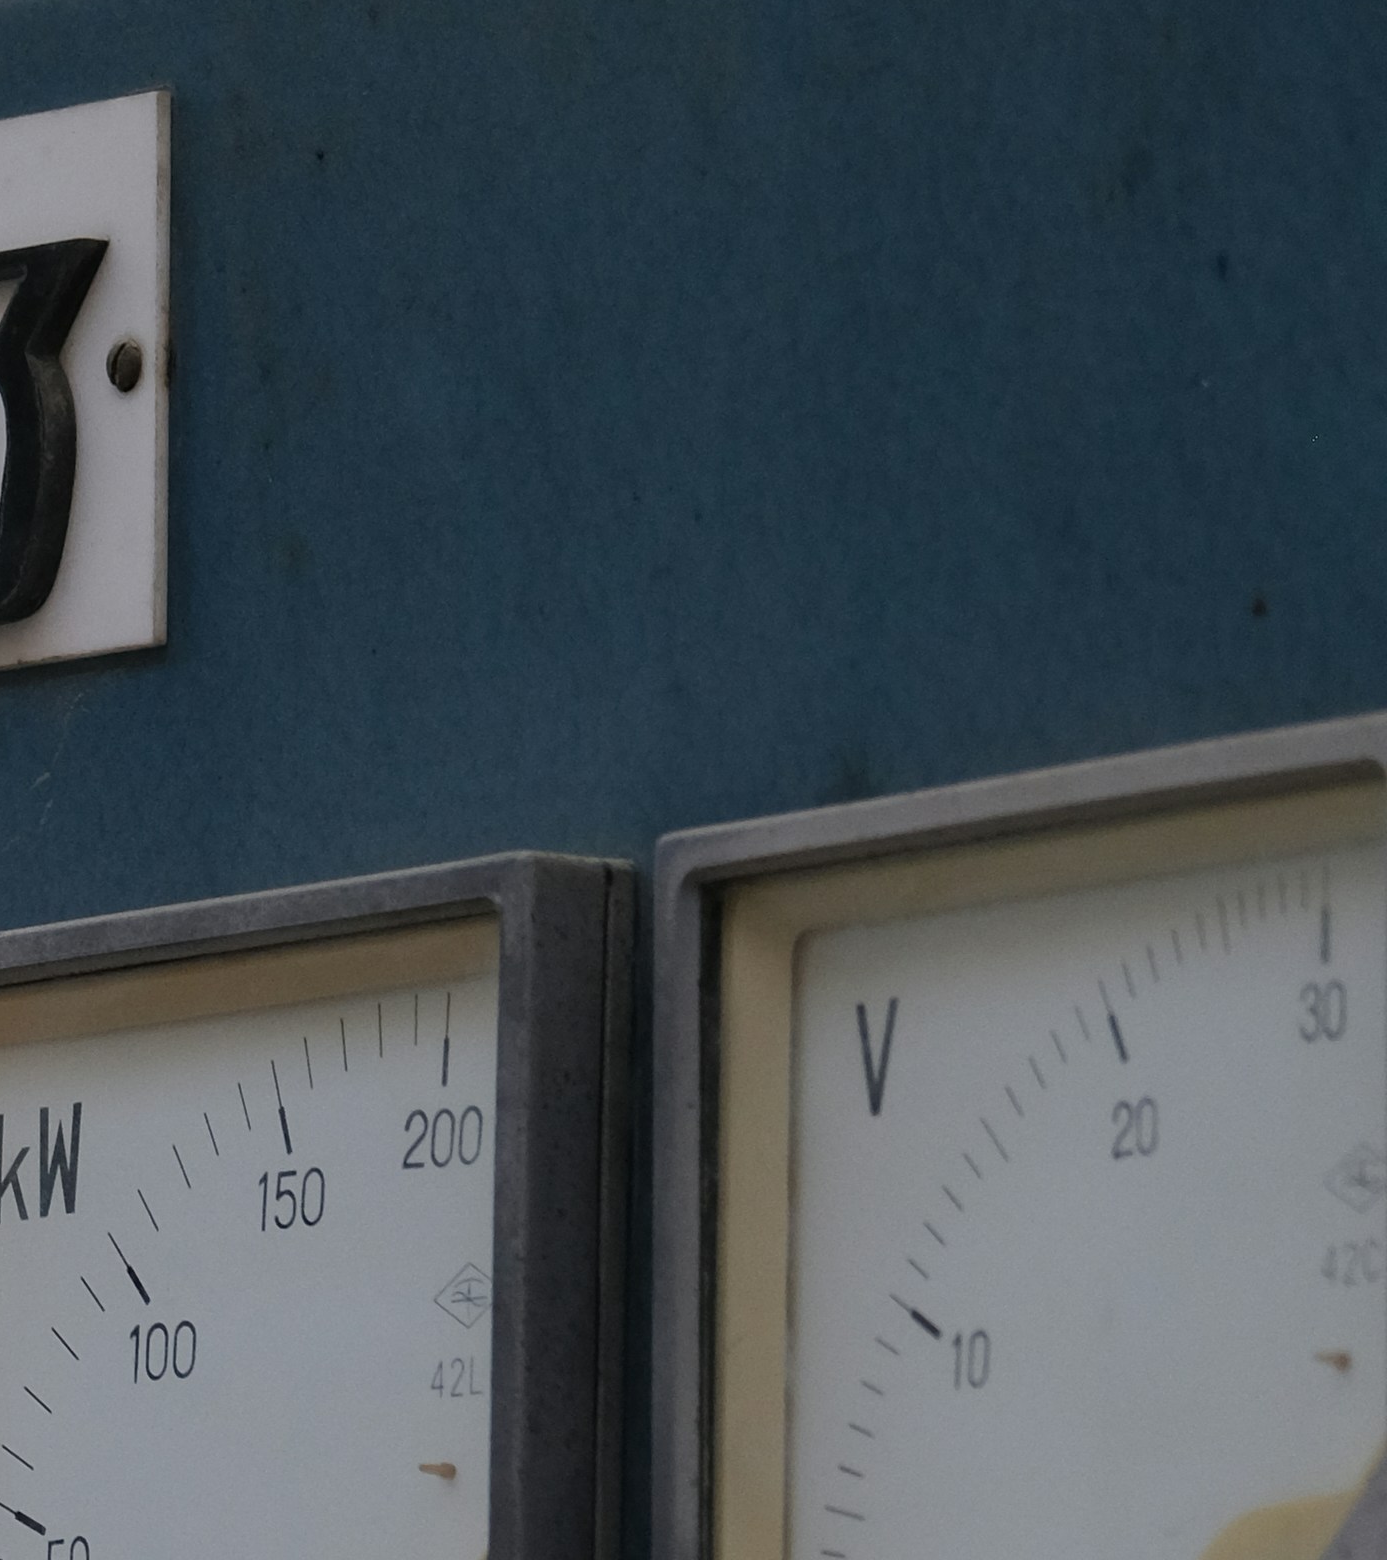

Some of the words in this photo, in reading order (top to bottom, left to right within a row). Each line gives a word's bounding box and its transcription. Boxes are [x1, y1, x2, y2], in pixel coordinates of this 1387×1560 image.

[1300, 981, 1348, 1046] 30
[855, 996, 899, 1117] V
[401, 1105, 483, 1172] 200
[1112, 1096, 1159, 1163] 20
[257, 1166, 326, 1234] 150
[128, 1319, 198, 1386] 100
[952, 1328, 991, 1392] 10
